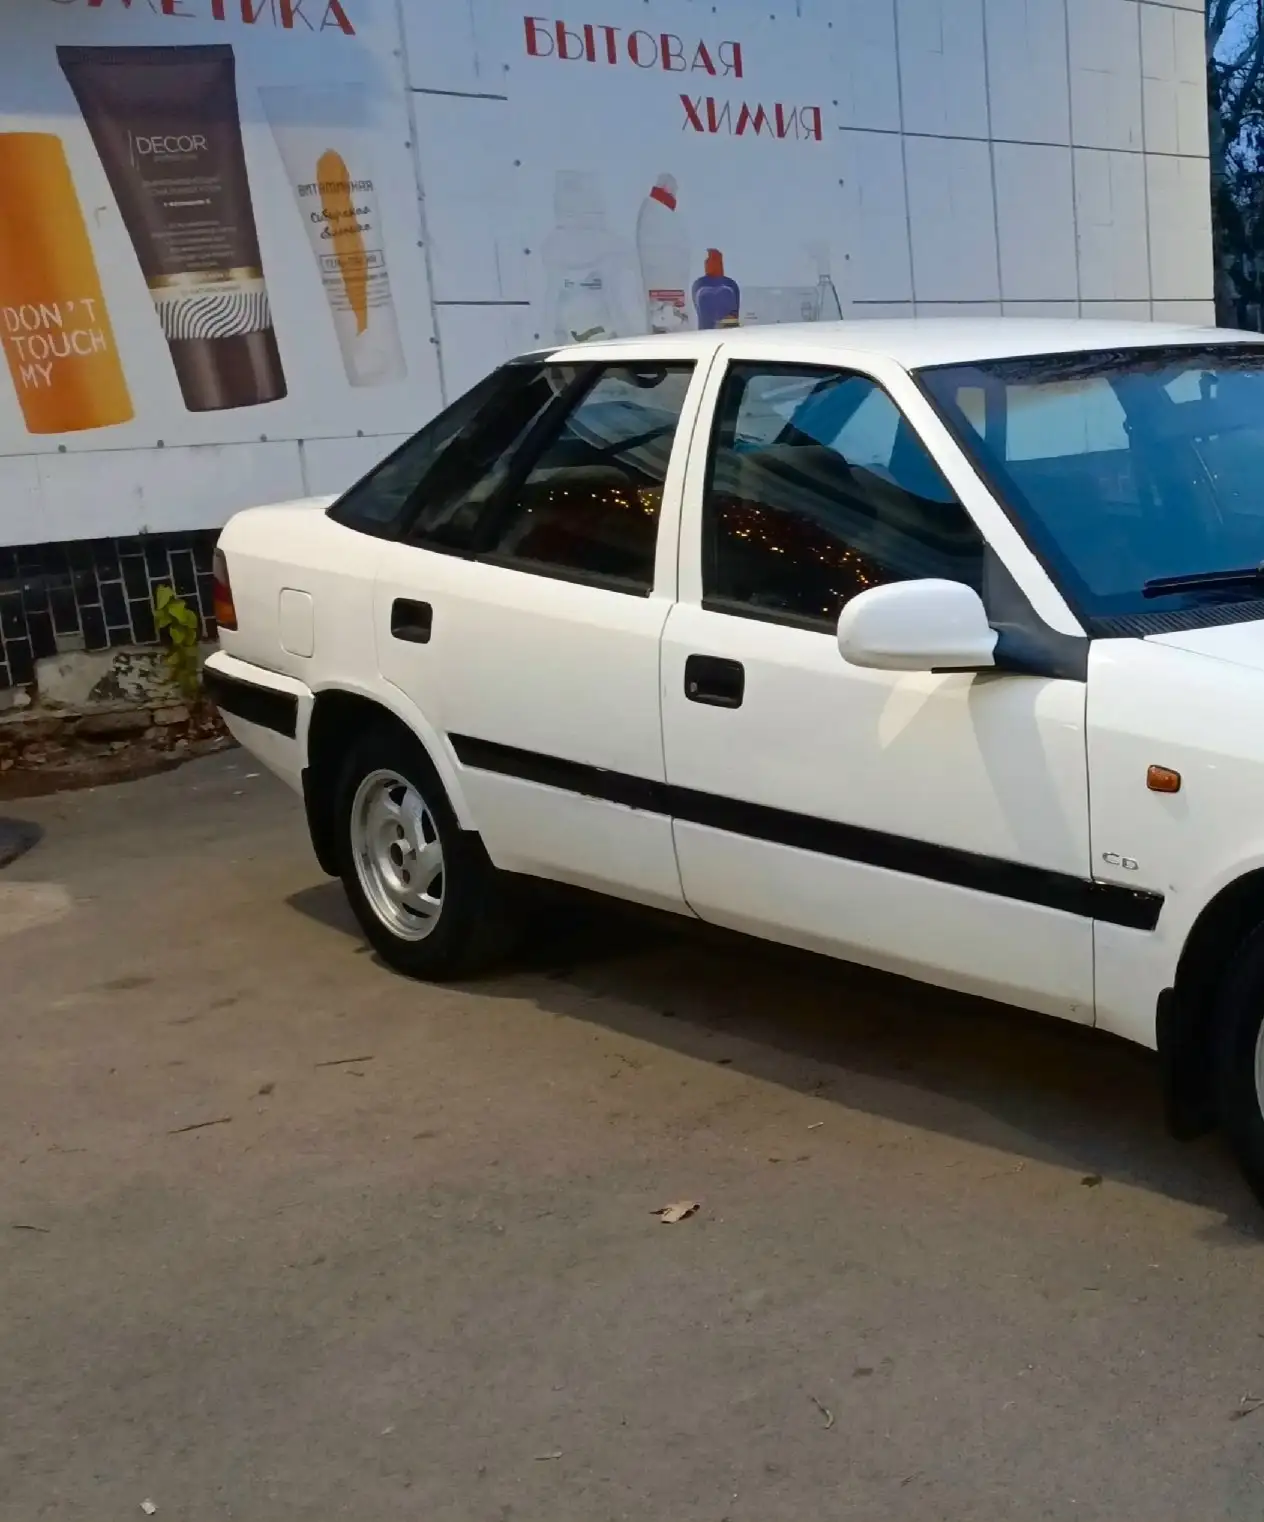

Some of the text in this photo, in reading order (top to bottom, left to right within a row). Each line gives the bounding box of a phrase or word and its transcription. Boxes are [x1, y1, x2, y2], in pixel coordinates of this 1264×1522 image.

[523, 16, 743, 78] БЫТОВАЯ
[679, 94, 822, 141] ХИМИЯ
[135, 134, 208, 155] DECOR
[3, 298, 95, 332] DON'T
[10, 328, 107, 362] TOUCH
[18, 361, 53, 389] MY
[1102, 852, 1139, 870] CD
